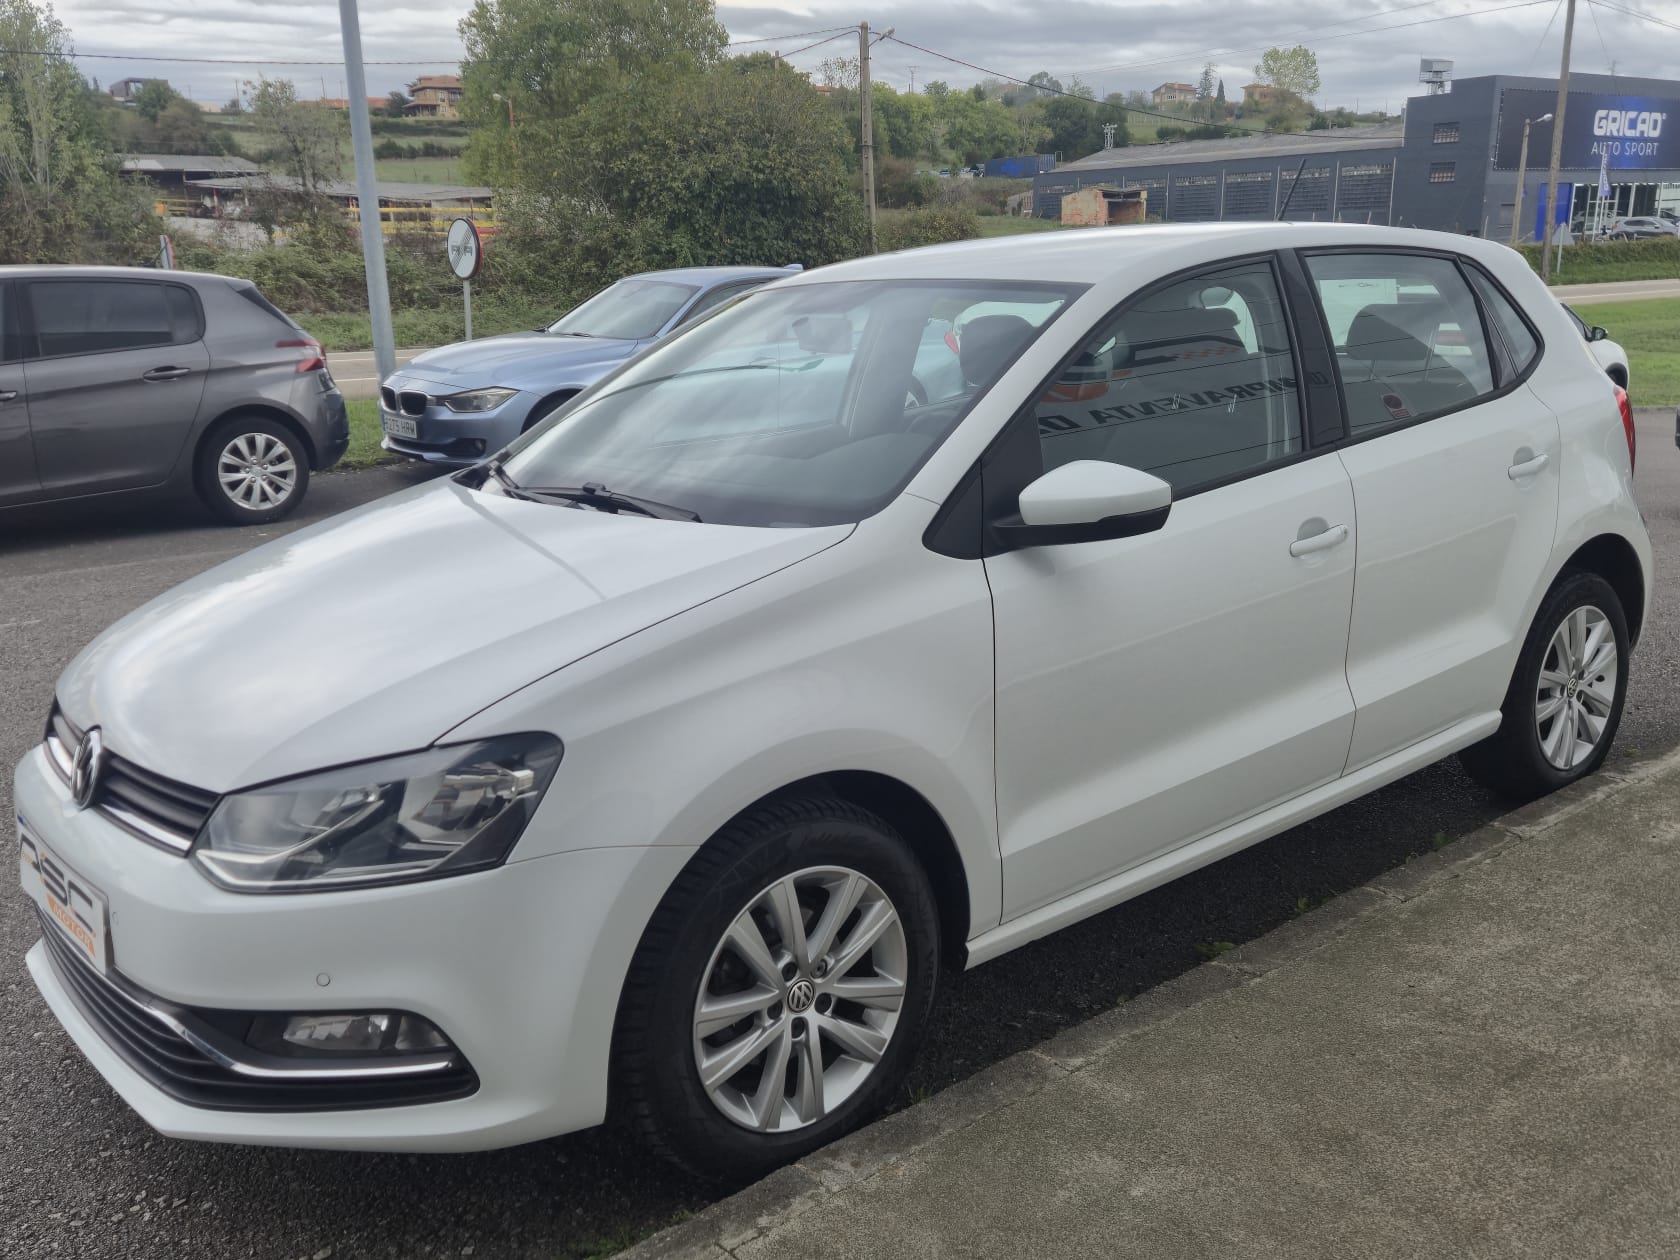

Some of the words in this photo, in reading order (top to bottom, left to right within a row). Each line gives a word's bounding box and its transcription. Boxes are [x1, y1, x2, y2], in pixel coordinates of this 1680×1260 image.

[1593, 109, 1662, 137] GRICAD
[1591, 141, 1620, 156] AUTO
[1624, 142, 1659, 156] SPORT
